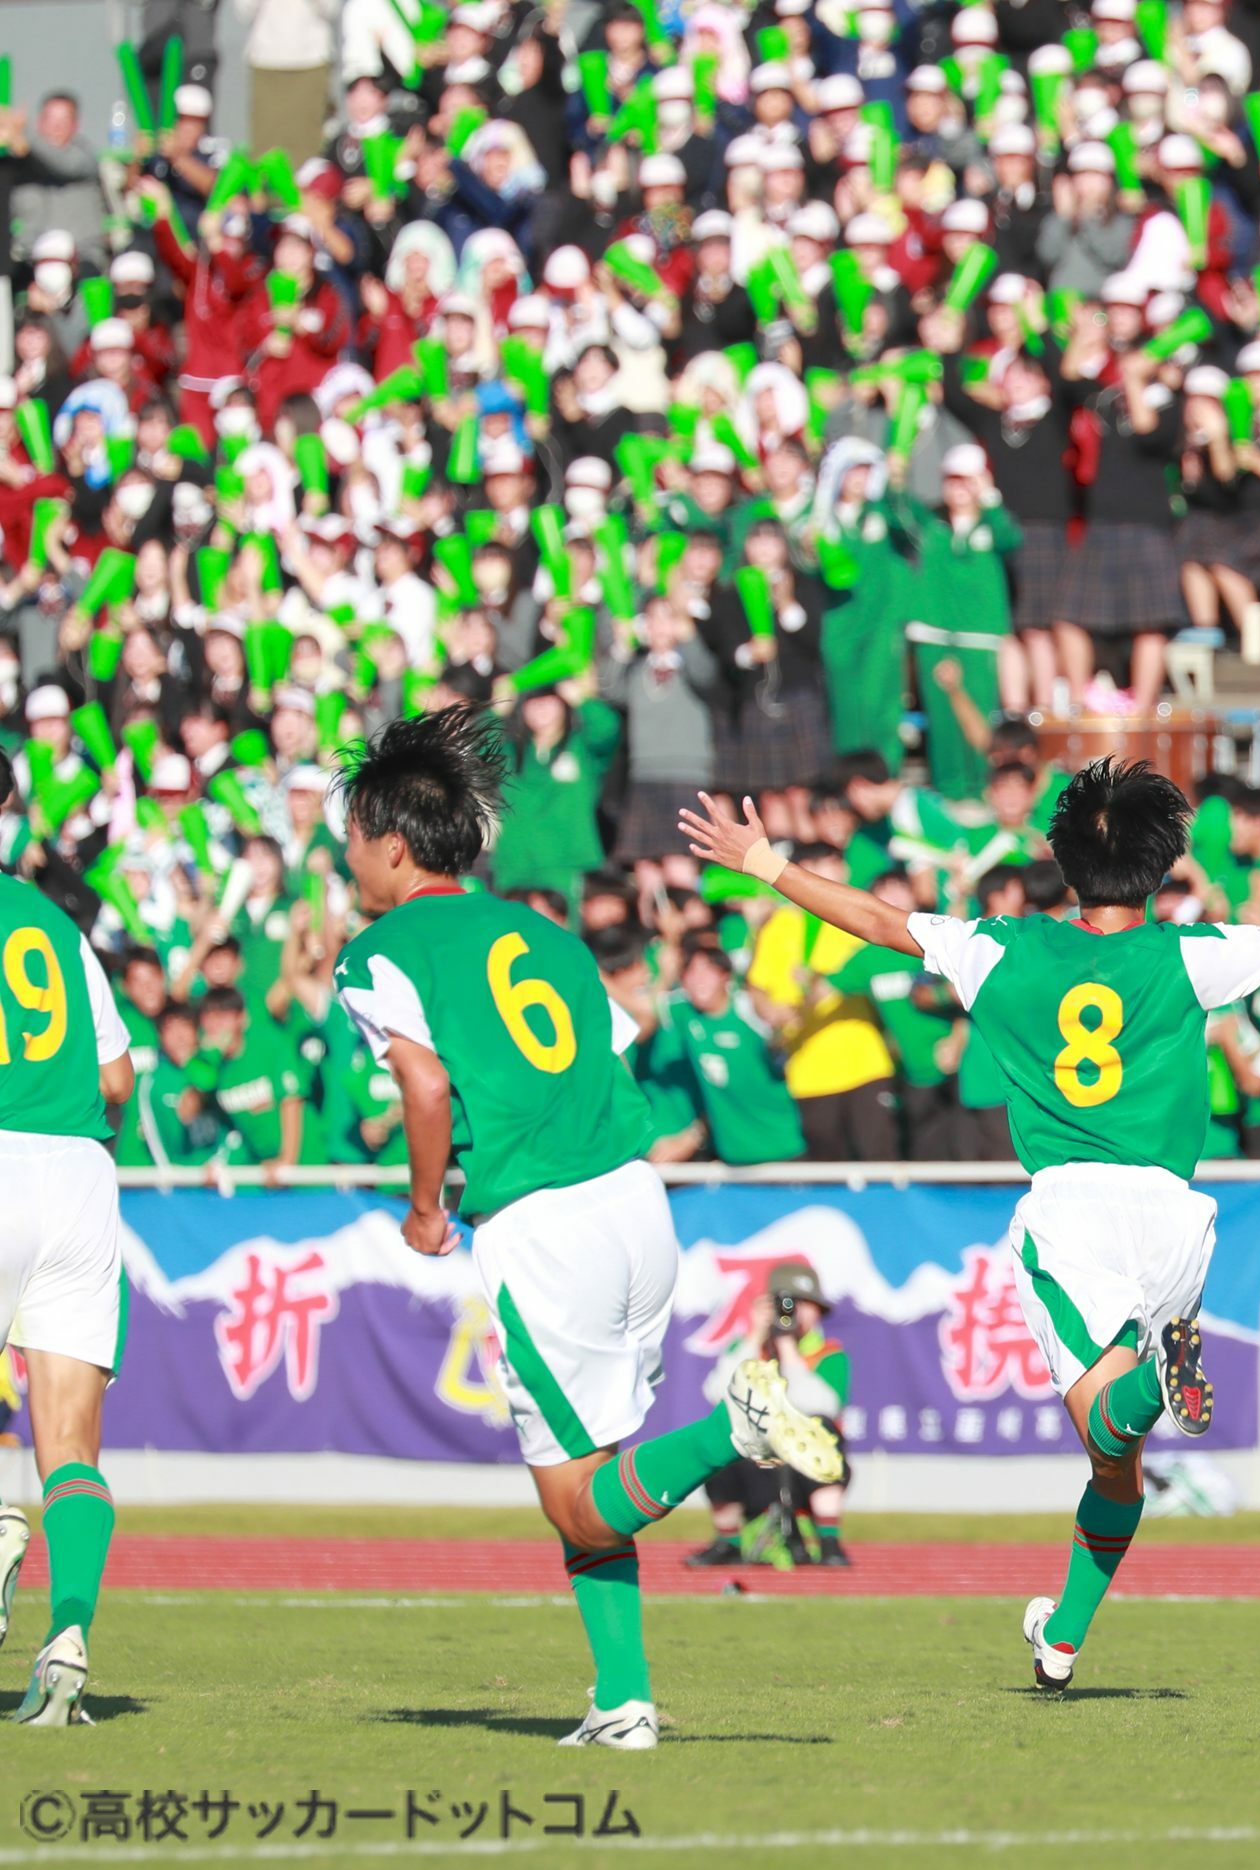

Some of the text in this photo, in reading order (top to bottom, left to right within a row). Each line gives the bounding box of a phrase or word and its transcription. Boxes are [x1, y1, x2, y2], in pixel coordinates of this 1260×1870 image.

[487, 932, 577, 1074] 6
[1053, 982, 1124, 1107] 8
[222, 1250, 336, 1397] 折
